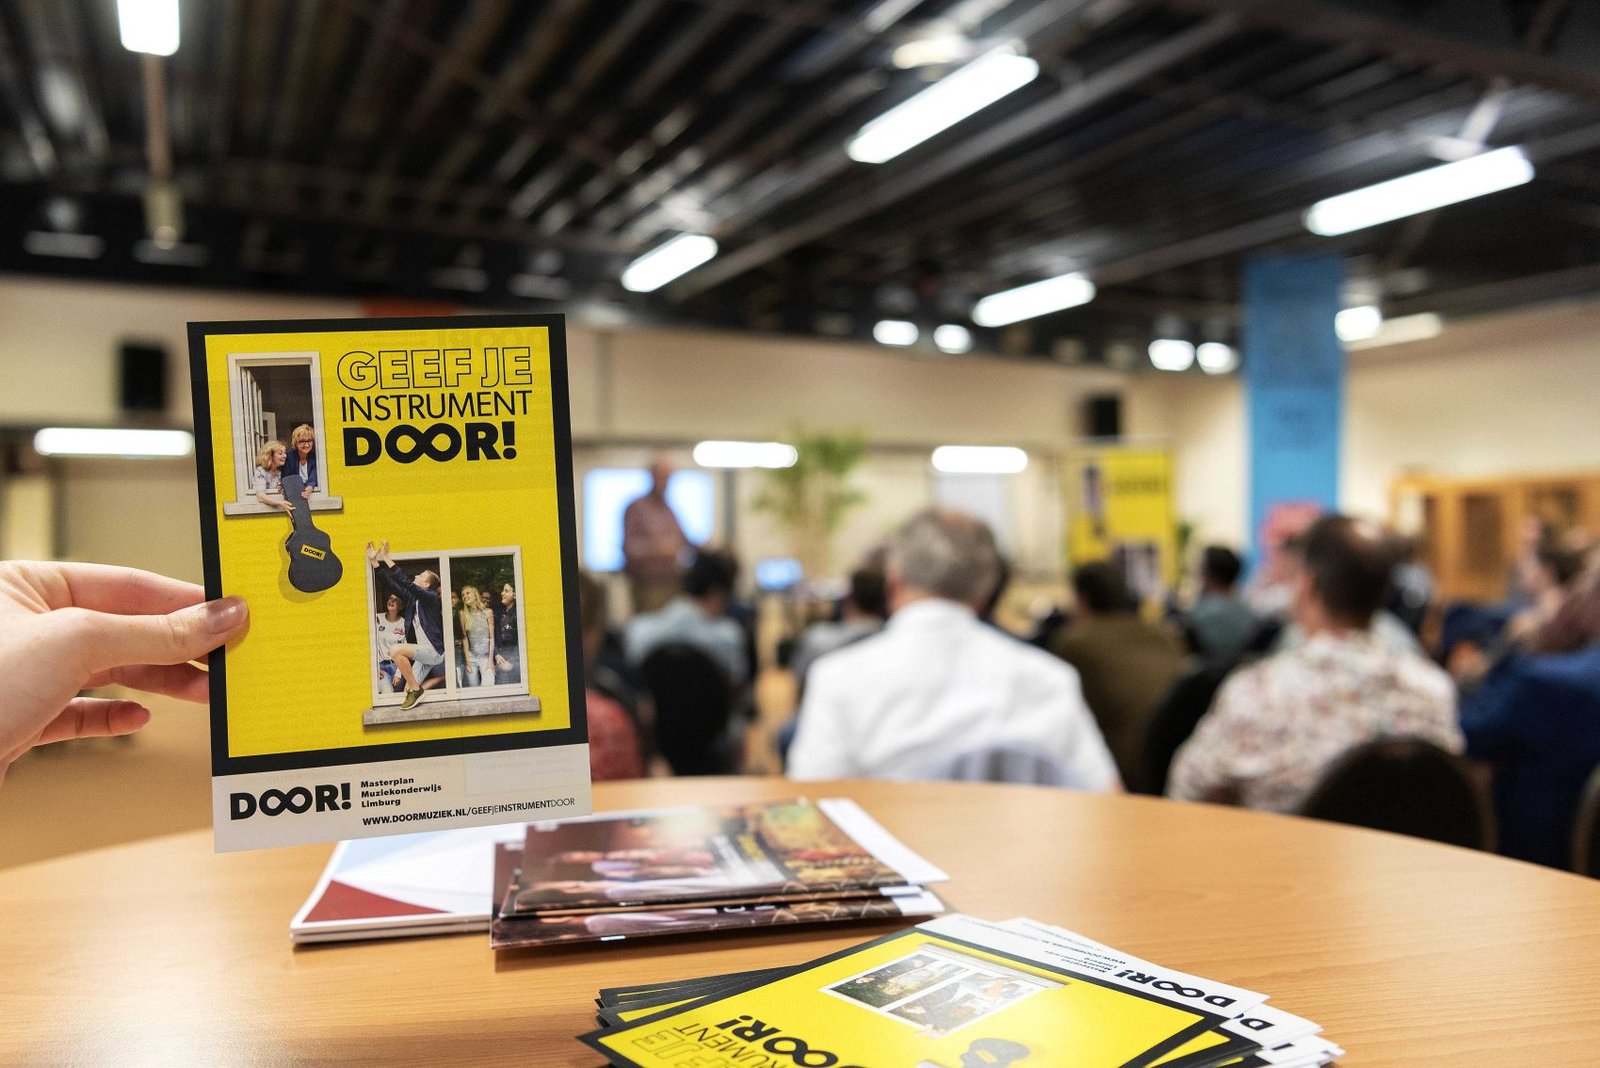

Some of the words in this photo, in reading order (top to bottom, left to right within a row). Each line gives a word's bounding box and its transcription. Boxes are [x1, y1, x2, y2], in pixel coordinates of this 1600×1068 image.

[337, 348, 472, 391] GEEF
[481, 346, 533, 388] JE
[341, 390, 533, 422] INSTRUMENT
[342, 420, 517, 467] DOOR!
[360, 776, 415, 788] Masterplan
[361, 784, 442, 798] Muziekonderwijs
[229, 782, 352, 821] DOOR!
[361, 798, 401, 808] Limburg
[362, 797, 576, 827] WWW.DOORMUZIEK.NL/GEEFJEINSTRUMENTDOOR
[1114, 968, 1238, 1008] DOOR!
[715, 1015, 867, 1068] OOR!
